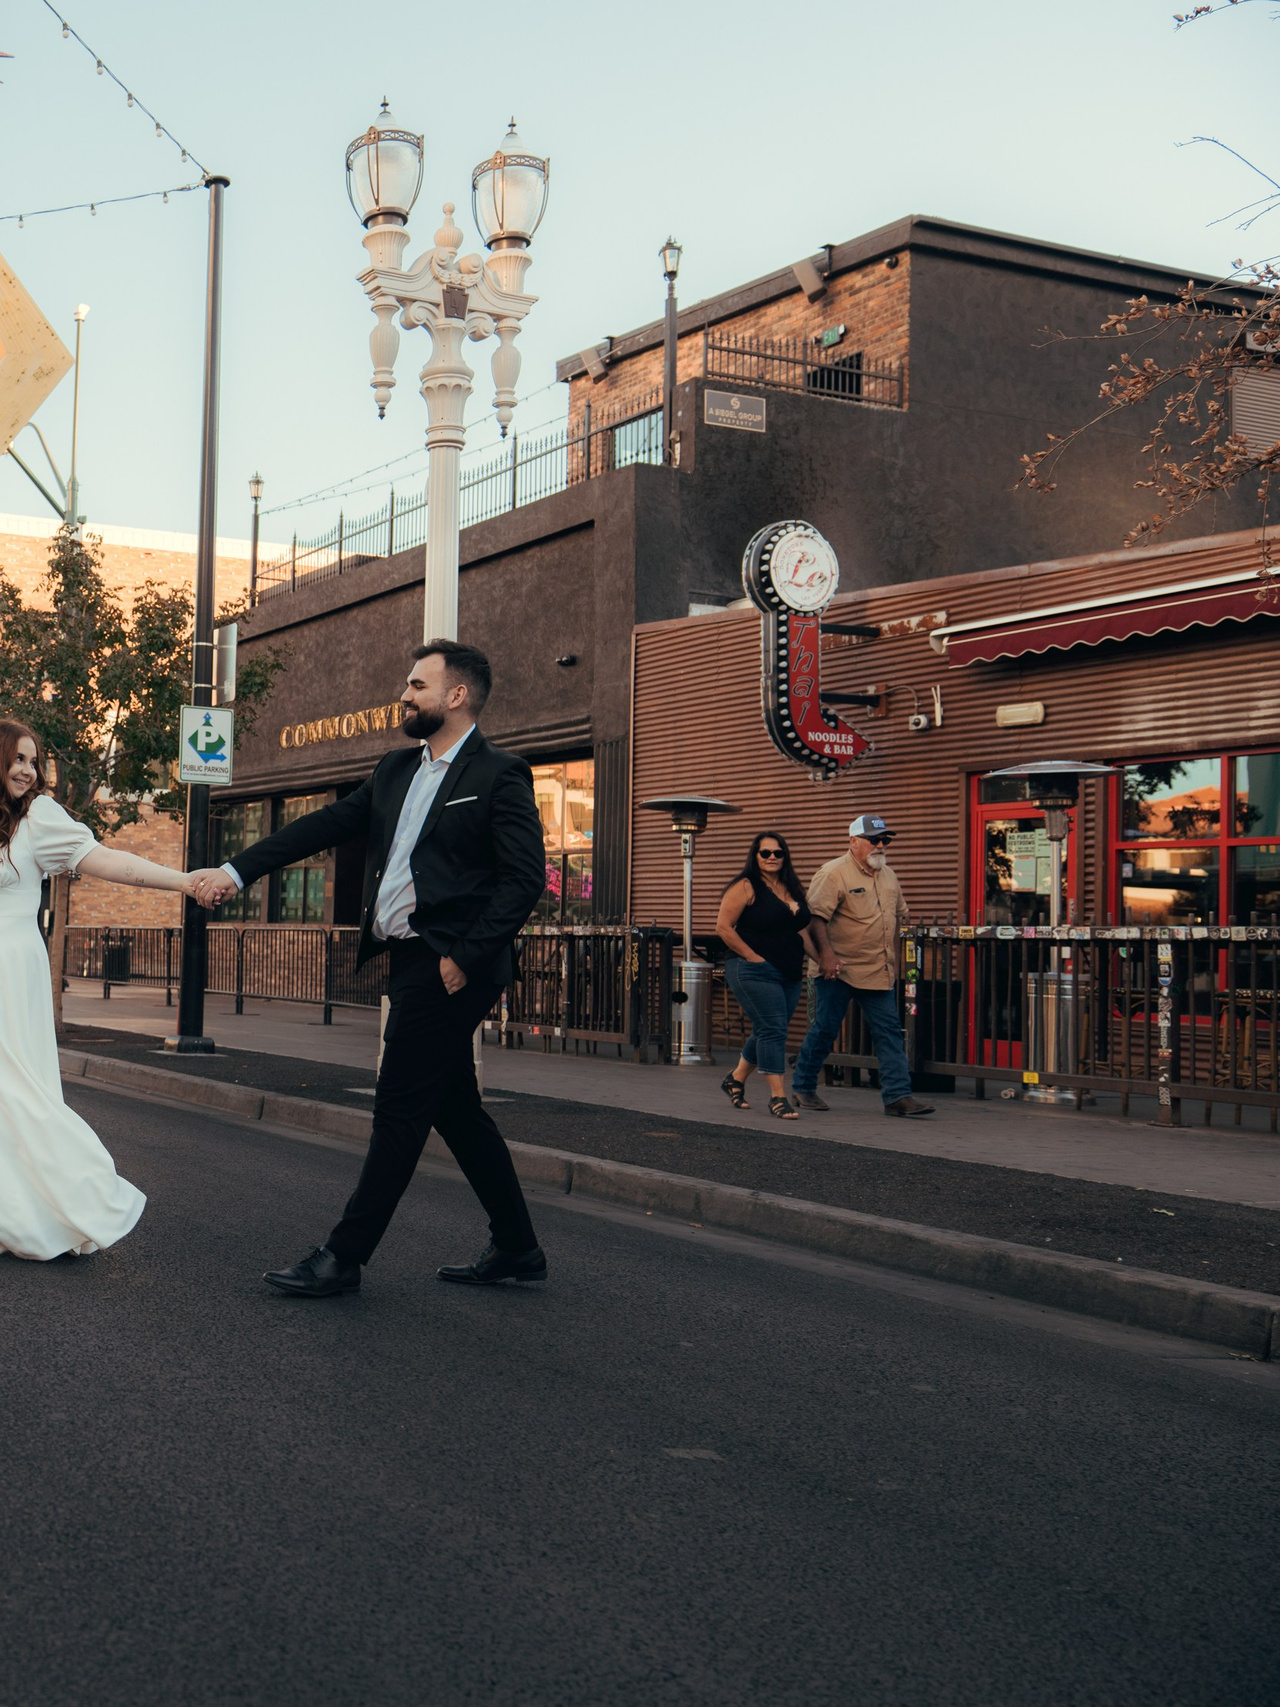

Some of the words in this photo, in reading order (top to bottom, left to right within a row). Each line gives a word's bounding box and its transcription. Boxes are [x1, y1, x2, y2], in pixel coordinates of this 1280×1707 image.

[715, 408, 737, 419] SIEGEL
[738, 412, 762, 422] GROUP
[718, 417, 752, 426] PROPERTY
[792, 620, 816, 725] Thai
[280, 701, 405, 749] COMMONWE
[808, 731, 854, 743] NOODLES
[823, 744, 832, 754] &
[833, 745, 854, 755] BAR
[183, 764, 203, 772] PUBLIC
[204, 766, 229, 774] PARKING
